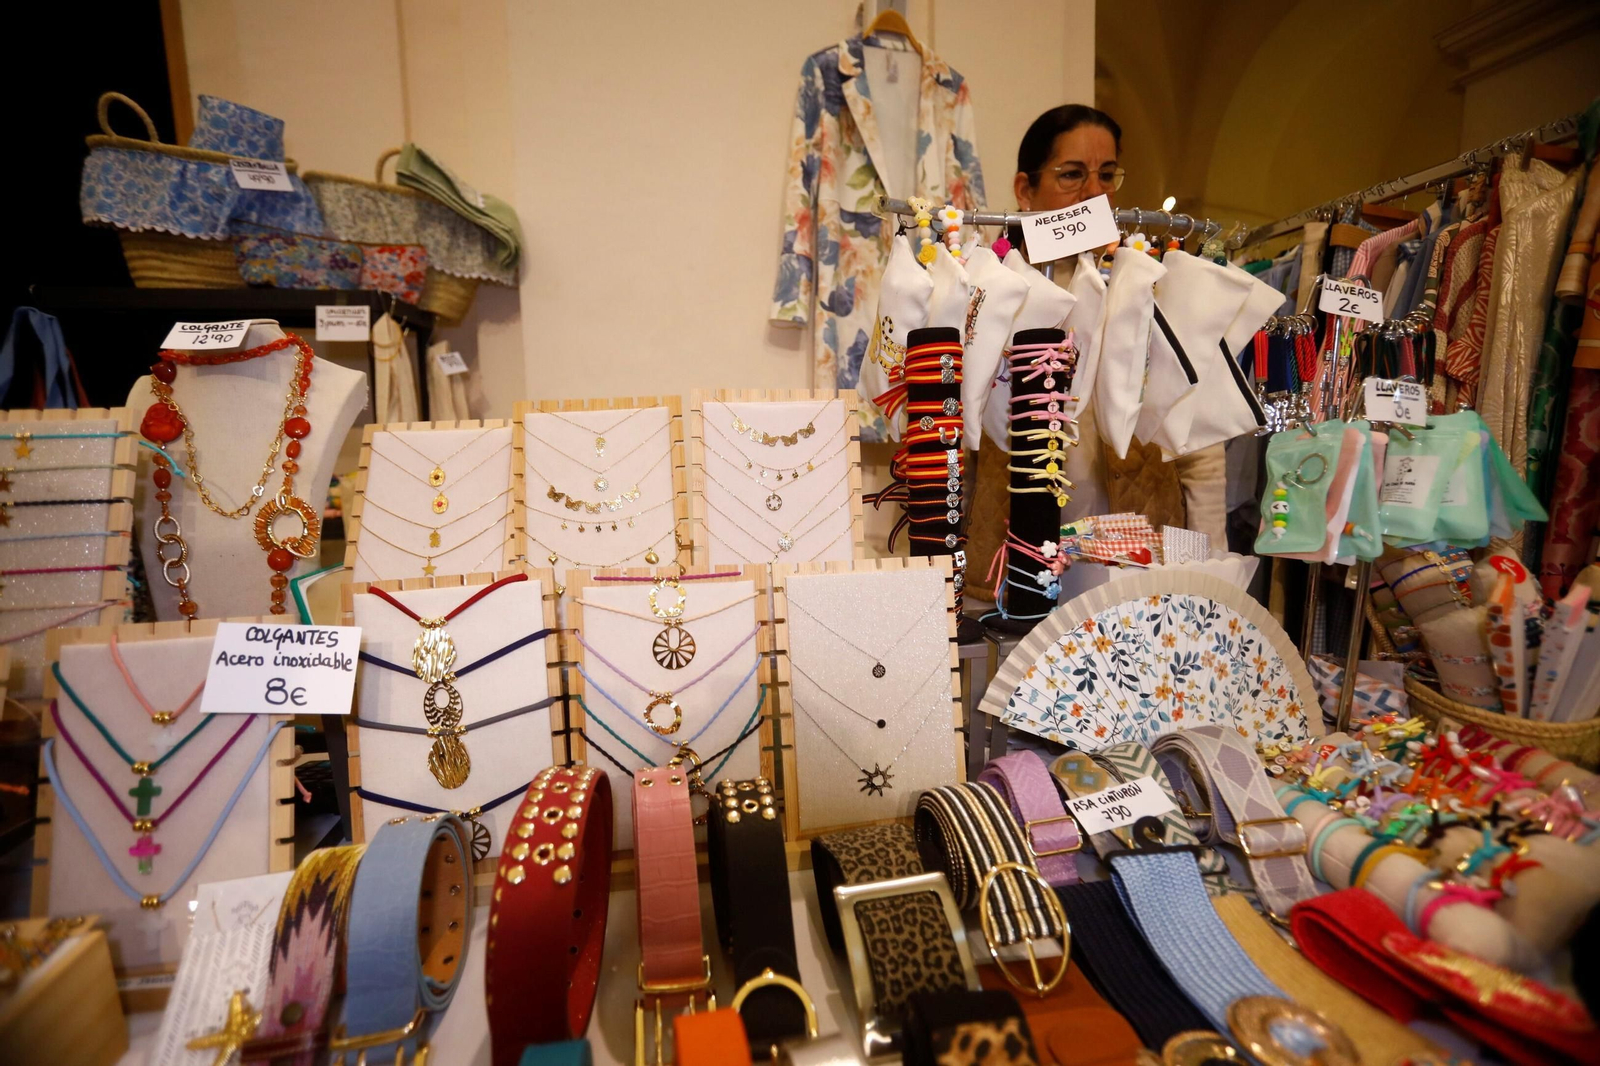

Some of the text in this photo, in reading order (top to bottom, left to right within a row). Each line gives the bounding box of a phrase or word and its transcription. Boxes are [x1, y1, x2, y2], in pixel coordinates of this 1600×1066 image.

[1034, 205, 1092, 227] NECESER
[1052, 221, 1087, 240] 5'90
[1338, 297, 1361, 314] 2€
[181, 321, 245, 333] COLGANTE
[192, 334, 234, 344] 12'90
[1375, 381, 1421, 396] LLAVEROS
[1393, 400, 1412, 420] 3€
[245, 626, 339, 651] COLGANTES
[216, 650, 354, 672] Acero inoxidable
[264, 677, 308, 706] 8€
[1072, 798, 1099, 812] ASA
[1101, 805, 1132, 823] 7'90
